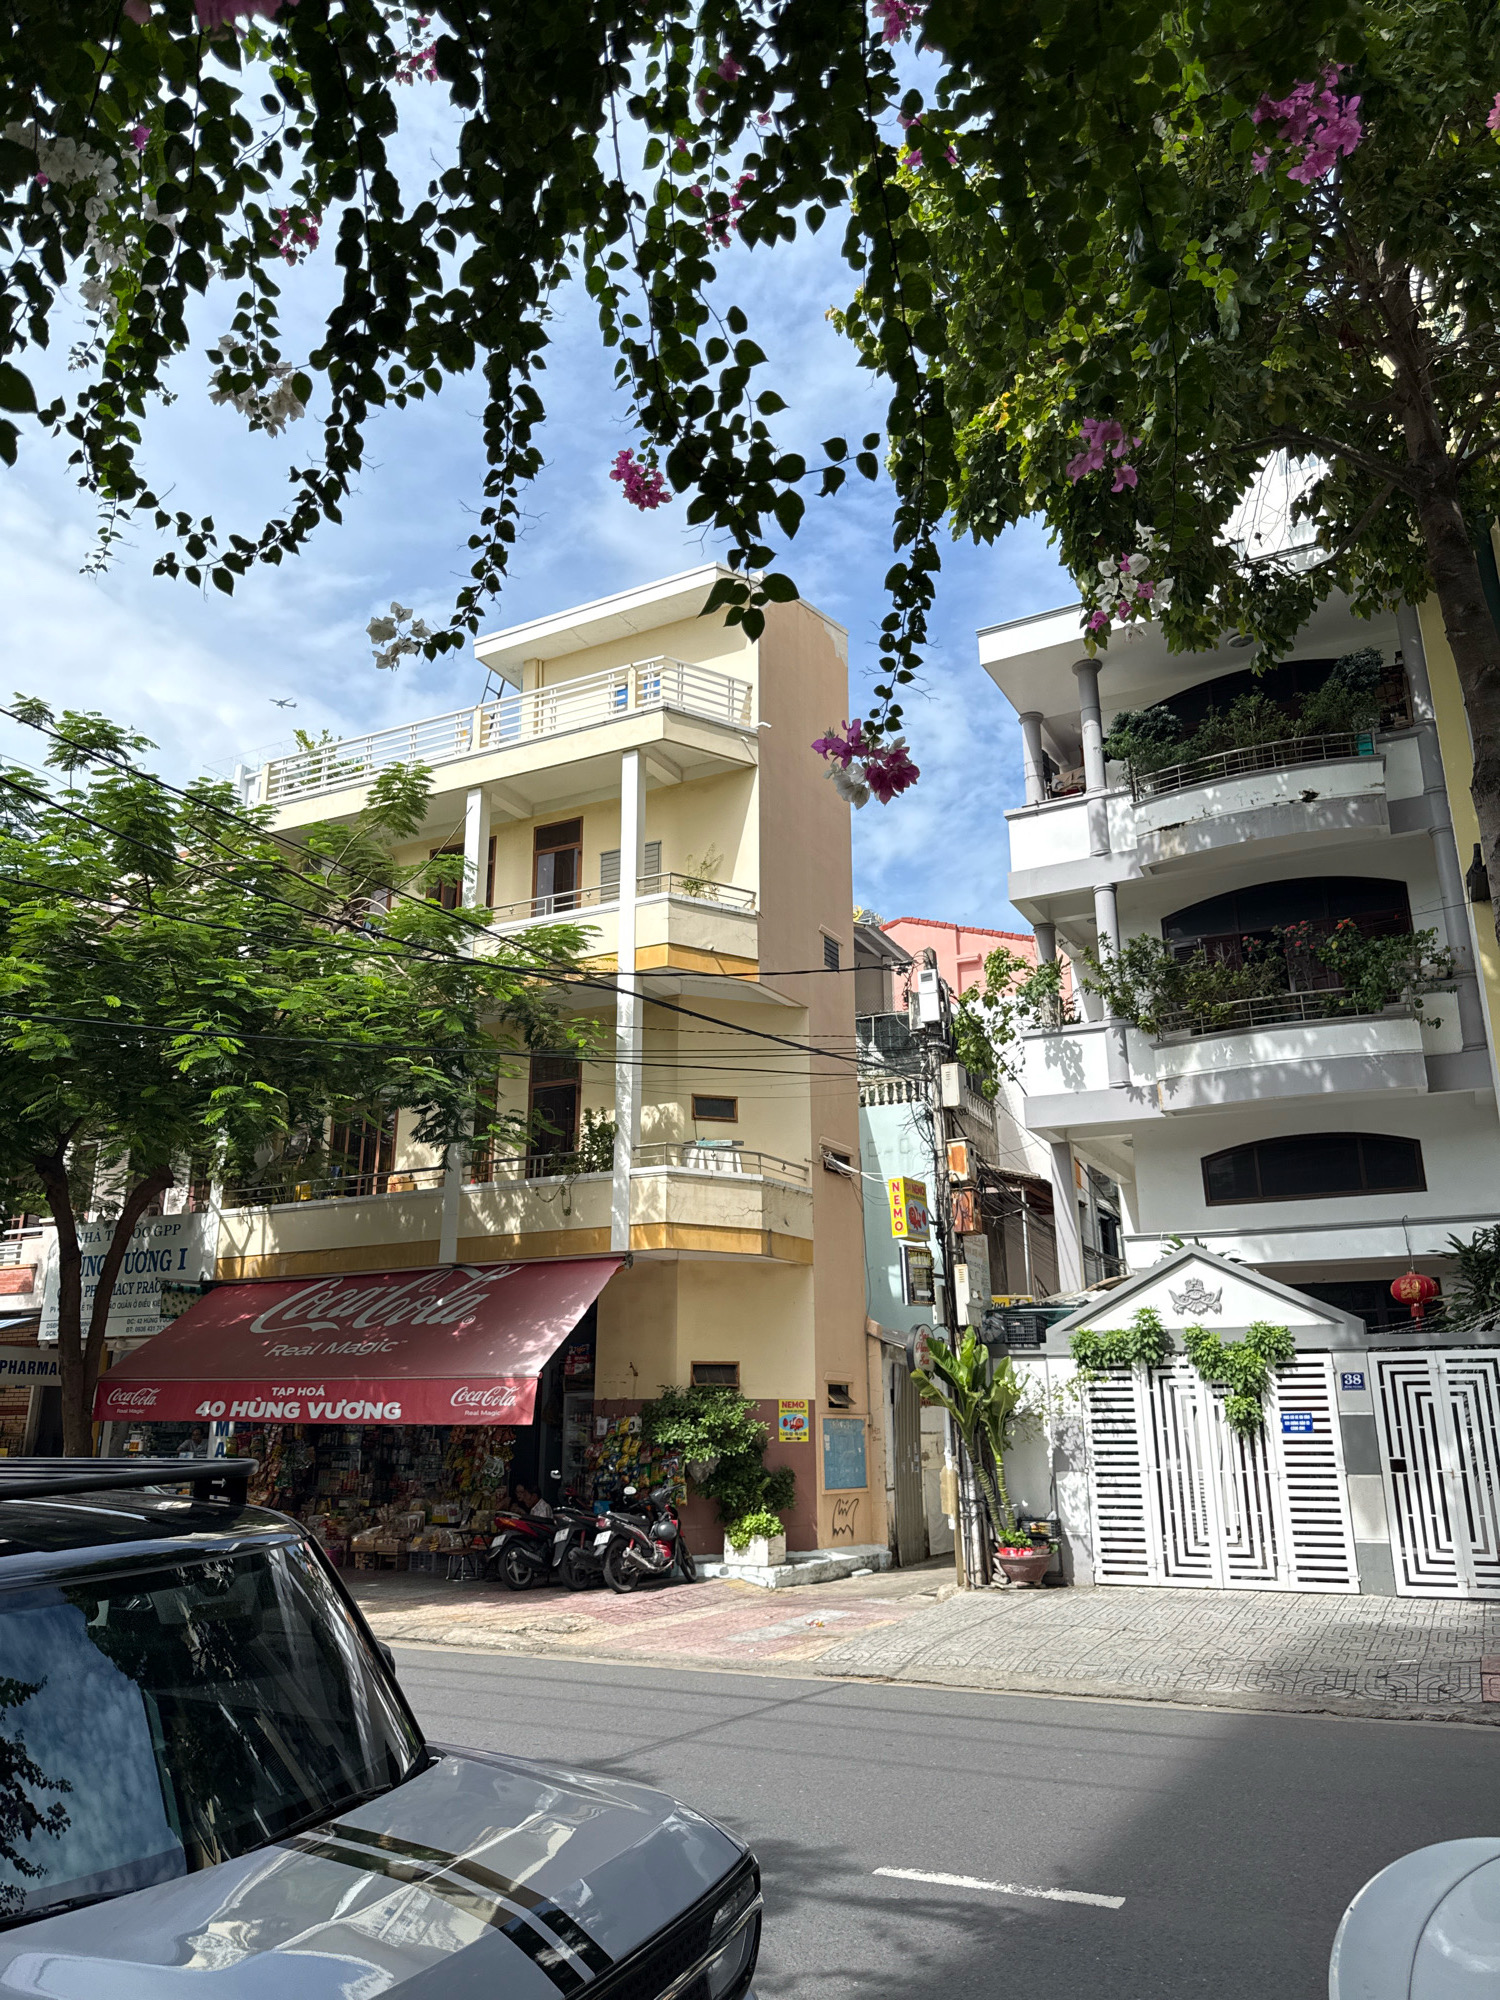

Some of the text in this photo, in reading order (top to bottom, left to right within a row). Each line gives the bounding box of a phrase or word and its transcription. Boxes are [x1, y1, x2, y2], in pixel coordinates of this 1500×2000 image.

[891, 1181, 904, 1232] NEMO
[154, 1223, 182, 1237] GPP
[124, 1247, 173, 1275] ƯƠNG
[264, 1338, 400, 1357] Real Magic
[0, 1360, 61, 1376] PHARMA
[1344, 1373, 1362, 1385] 38
[271, 1384, 325, 1399] TẠP HOÁ
[195, 1396, 402, 1420] 40 HÙNG VƯƠNG
[781, 1400, 805, 1409] NEMO
[480, 1409, 501, 1417] Magic
